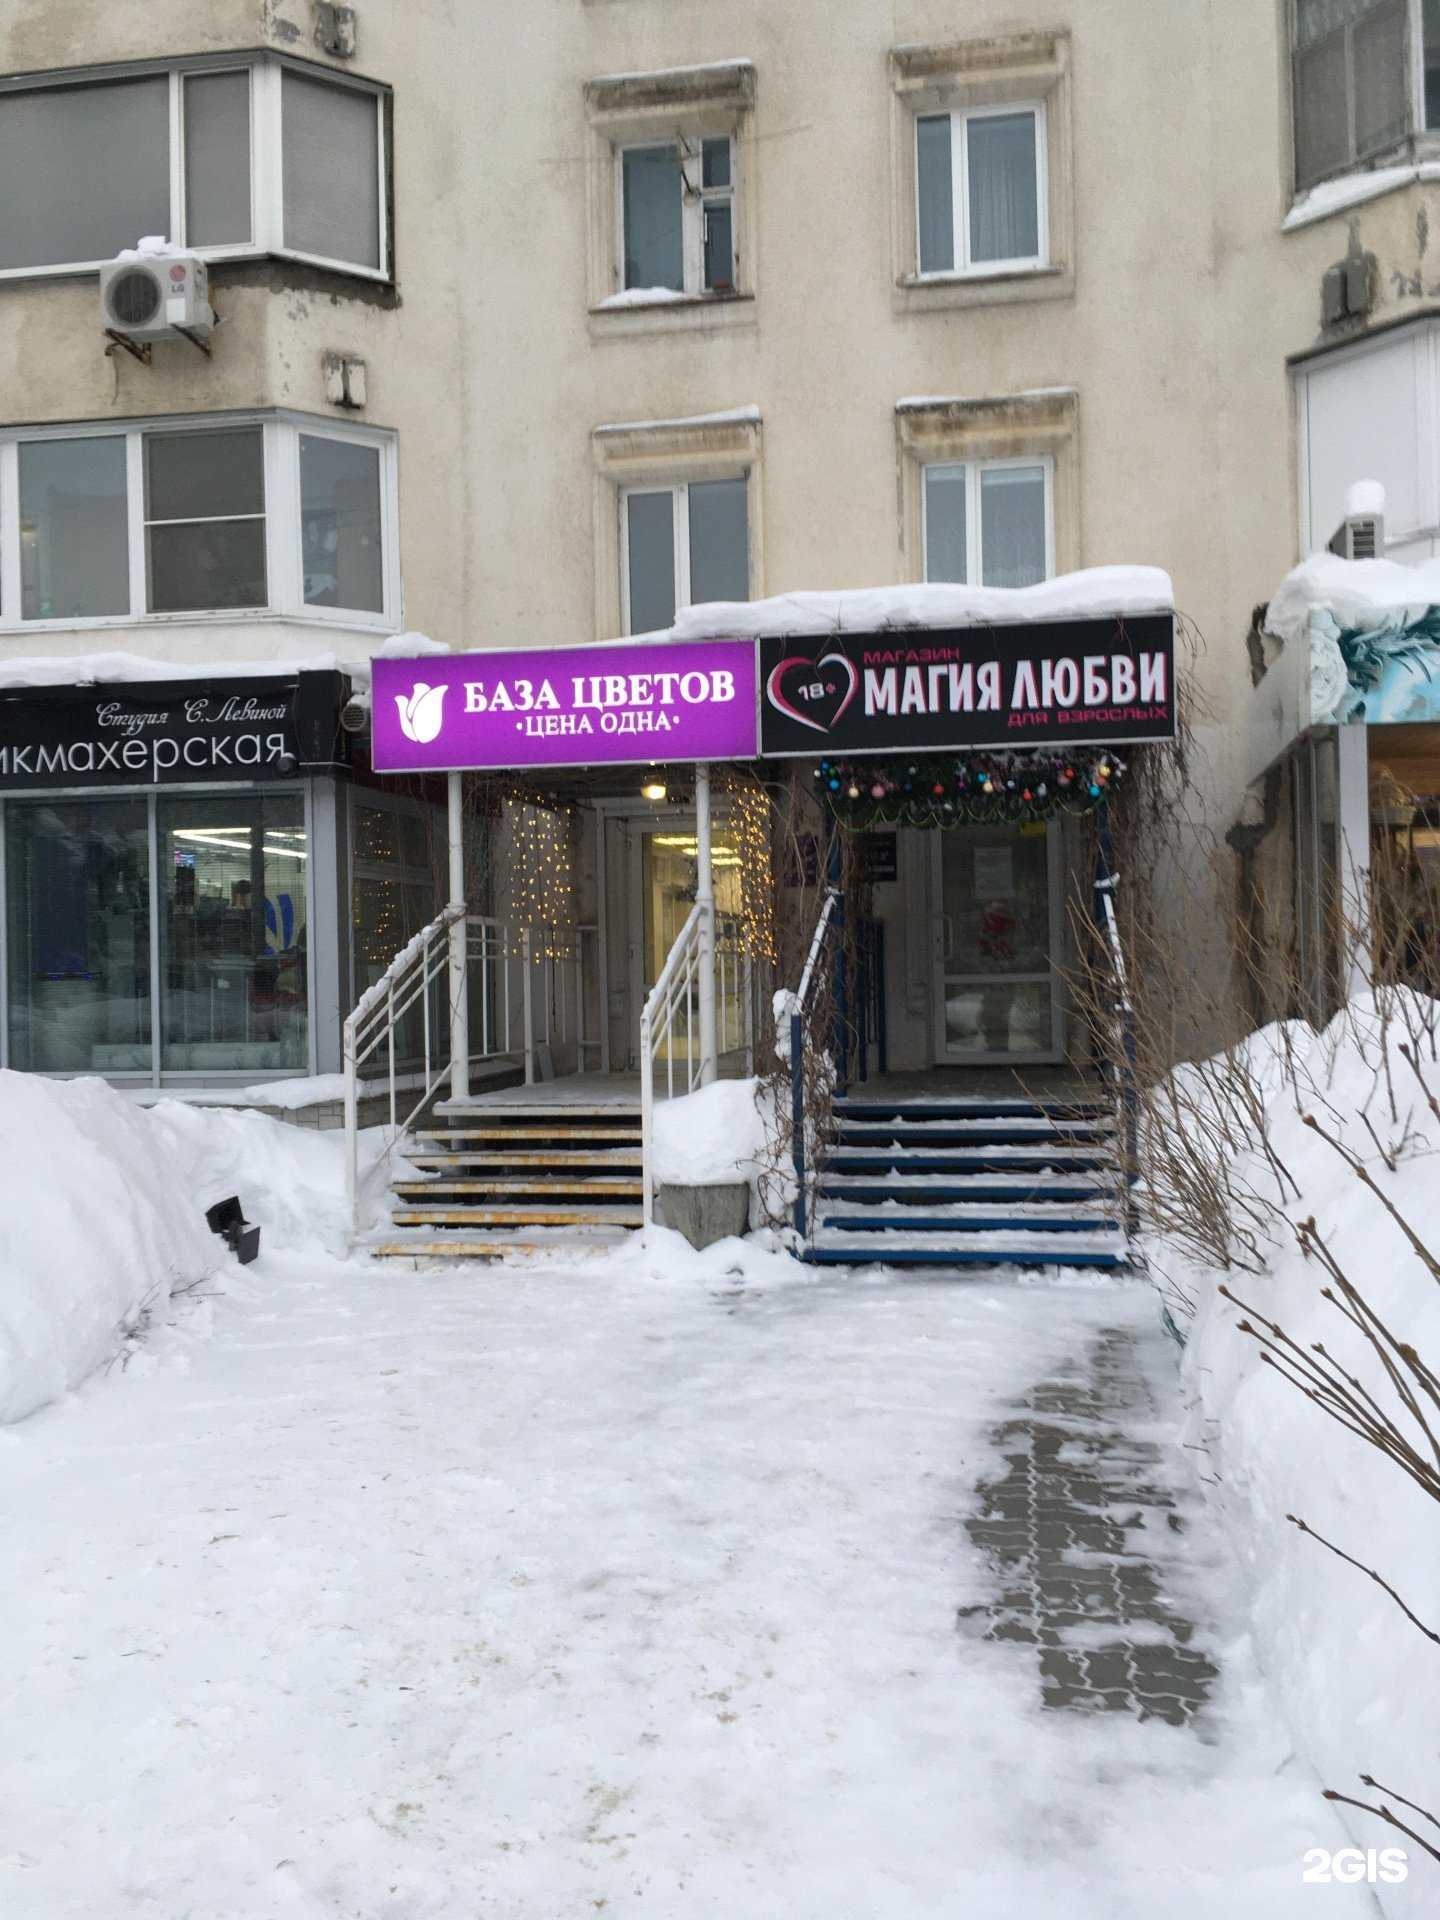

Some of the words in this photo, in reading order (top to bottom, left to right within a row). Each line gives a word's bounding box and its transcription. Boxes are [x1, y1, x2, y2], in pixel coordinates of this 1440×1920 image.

[864, 648, 960, 664] МАГАЗИН
[464, 679, 560, 713] БАЗА
[571, 670, 735, 713] ЦВЕТОВ
[798, 682, 836, 701] 18+
[864, 661, 1001, 716] МАГИЯ
[1010, 651, 1168, 710] ЛЮБВИ
[96, 702, 169, 736] Студия
[1007, 711, 1048, 728] ДЛЯ
[1057, 706, 1168, 724] ВЗРОСЛЫХ
